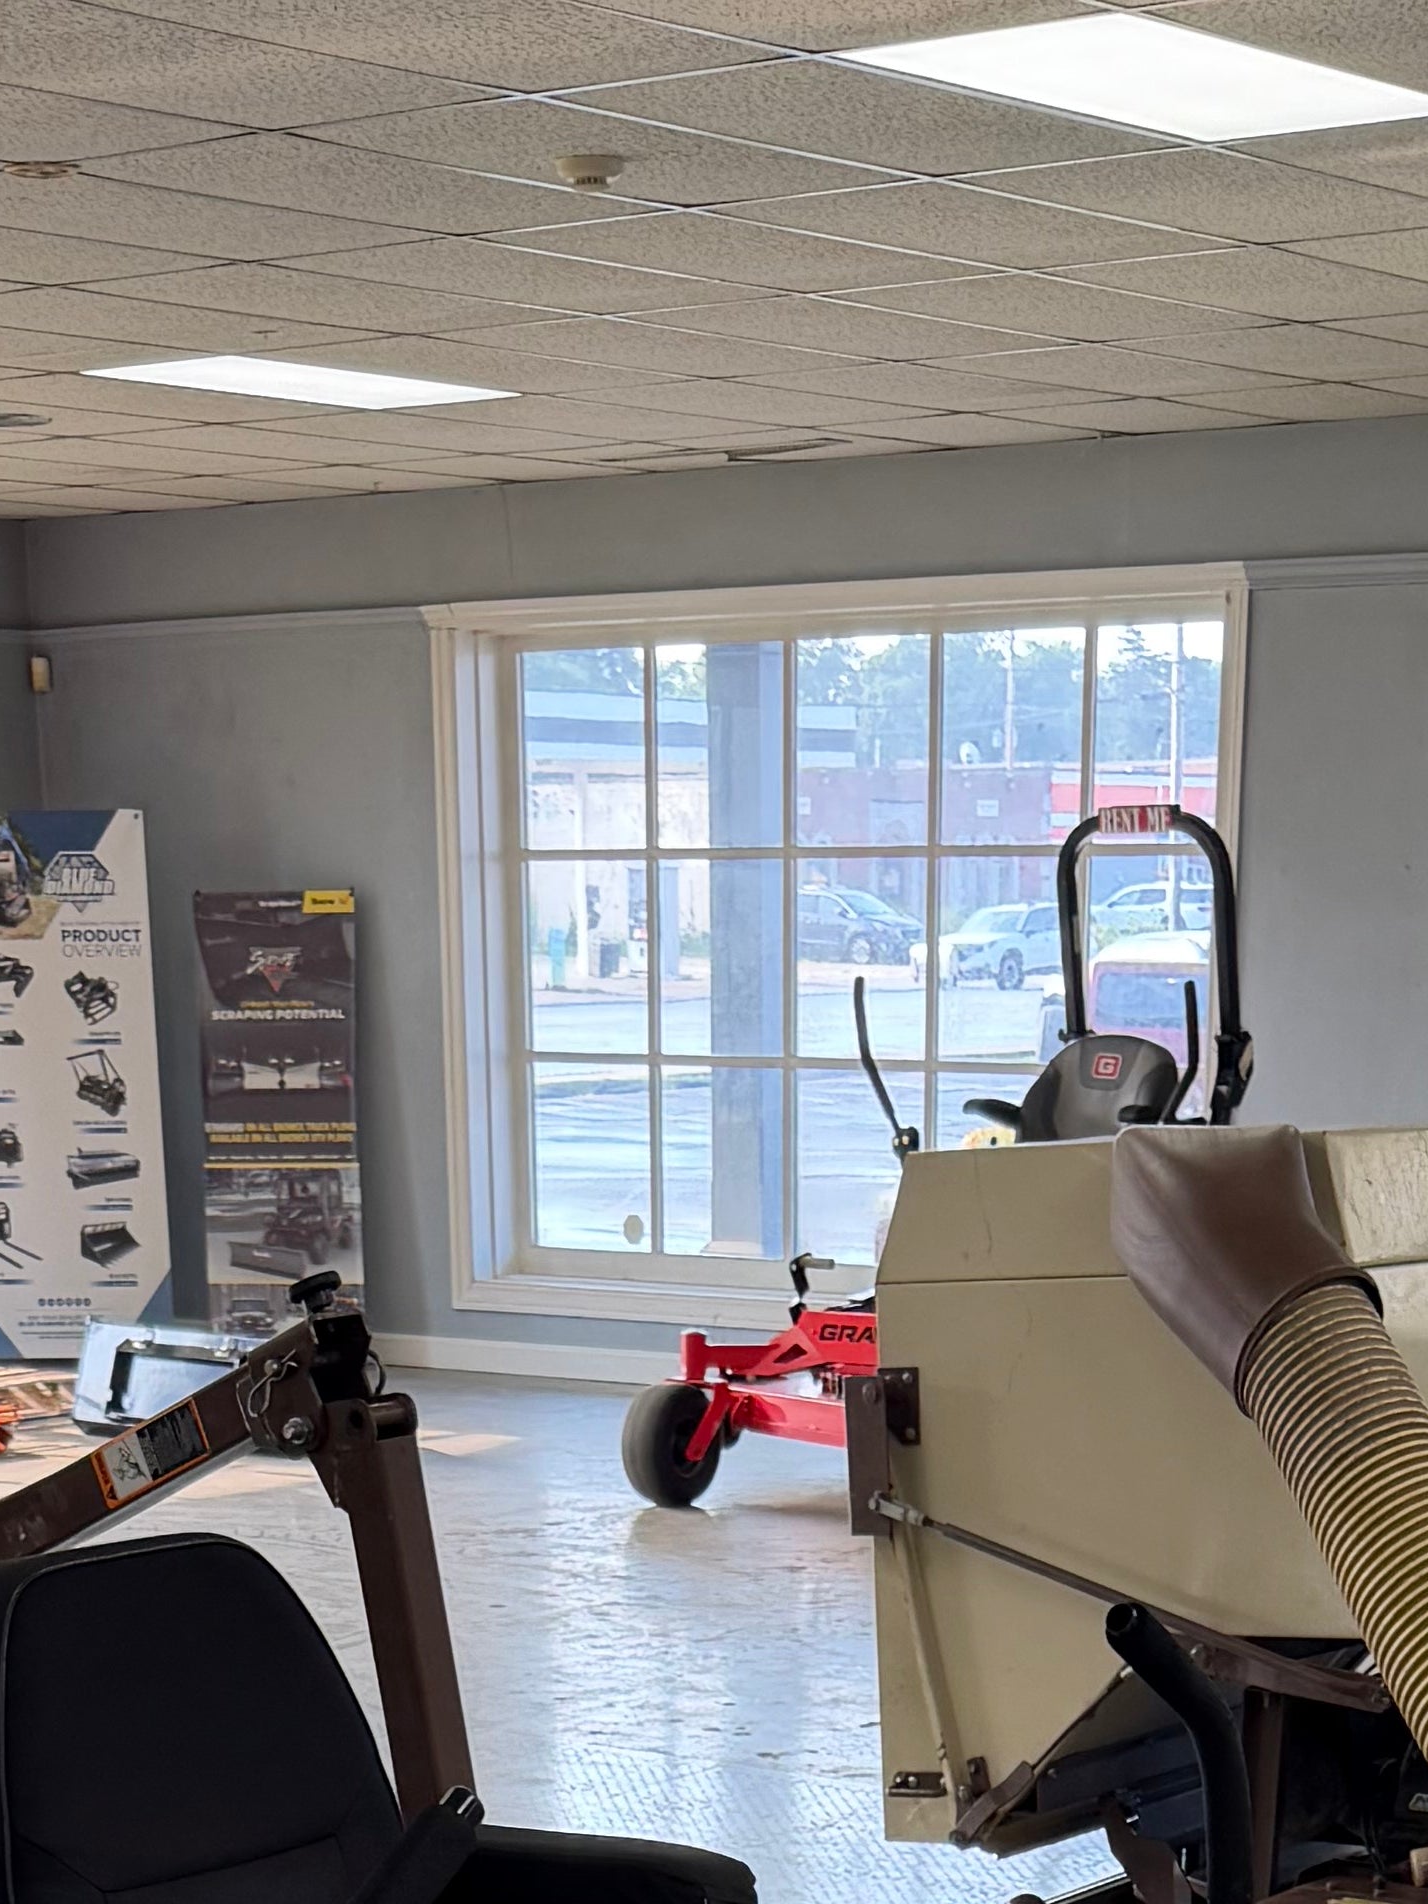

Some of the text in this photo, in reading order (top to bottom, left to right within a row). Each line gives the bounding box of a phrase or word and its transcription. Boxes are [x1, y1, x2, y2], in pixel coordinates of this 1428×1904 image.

[1101, 808, 1139, 832] RENT
[61, 929, 142, 942] PRODUCT
[63, 944, 142, 958] OVERVIEW
[212, 1009, 345, 1020] SCRAPING POTENTIAL
